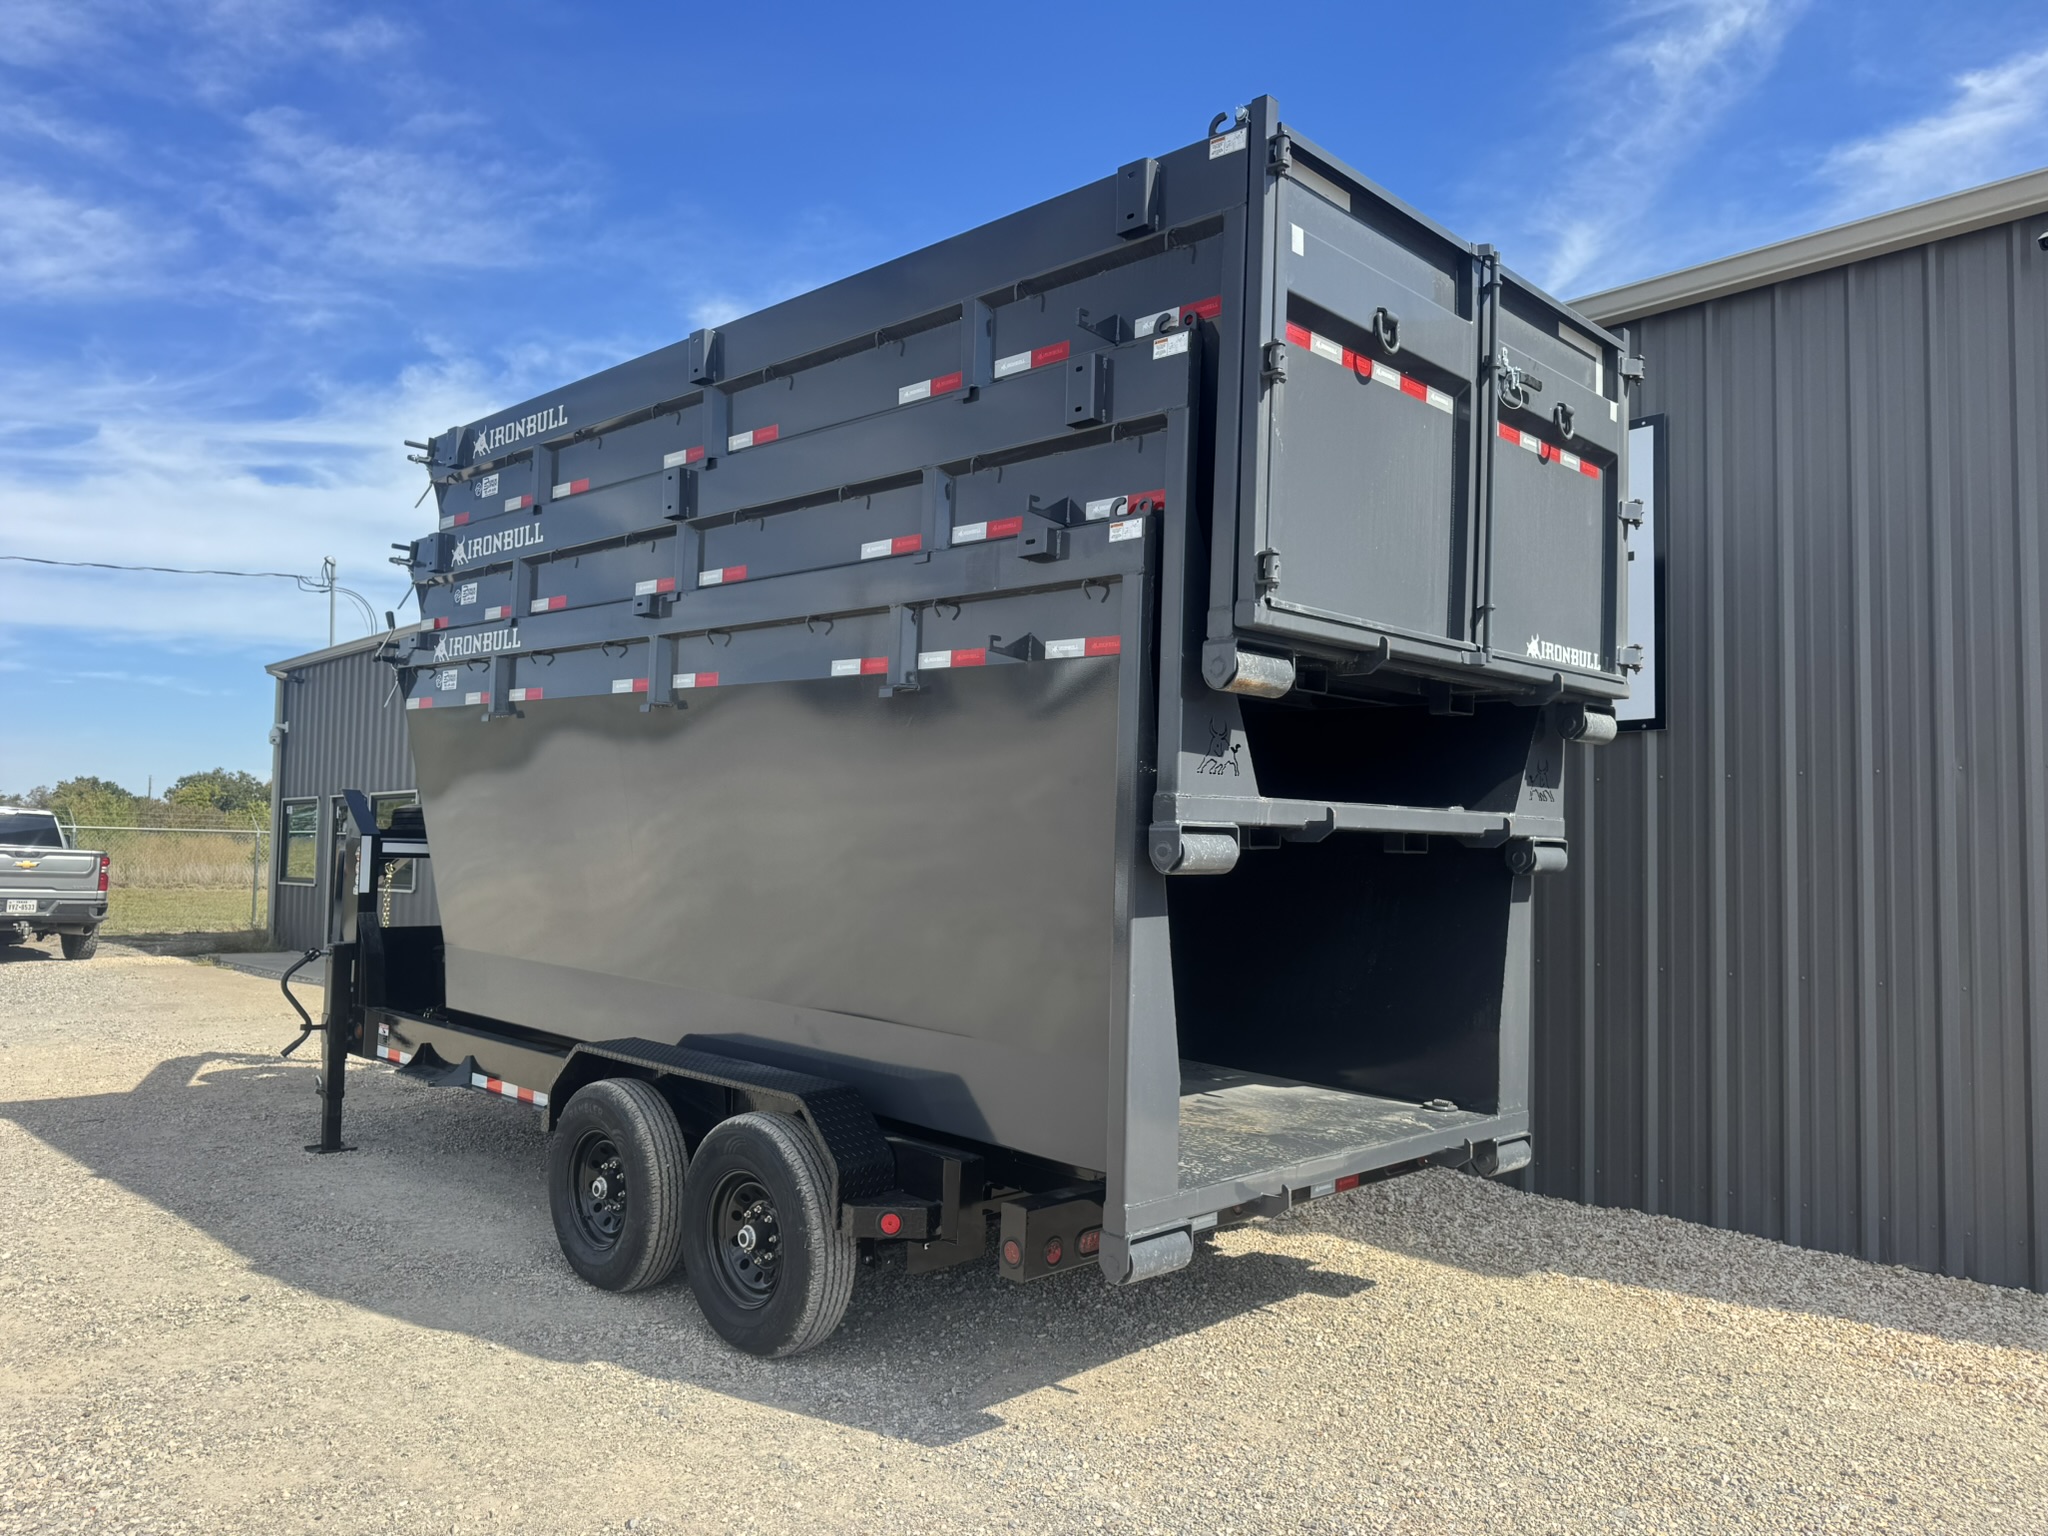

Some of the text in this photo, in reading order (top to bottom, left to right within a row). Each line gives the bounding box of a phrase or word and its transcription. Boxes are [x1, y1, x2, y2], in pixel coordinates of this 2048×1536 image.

[489, 405, 568, 449] IRONBULL
[467, 522, 544, 559] IRONBULL
[449, 628, 521, 657] IRONBULL
[1541, 641, 1601, 671] IRONBULL
